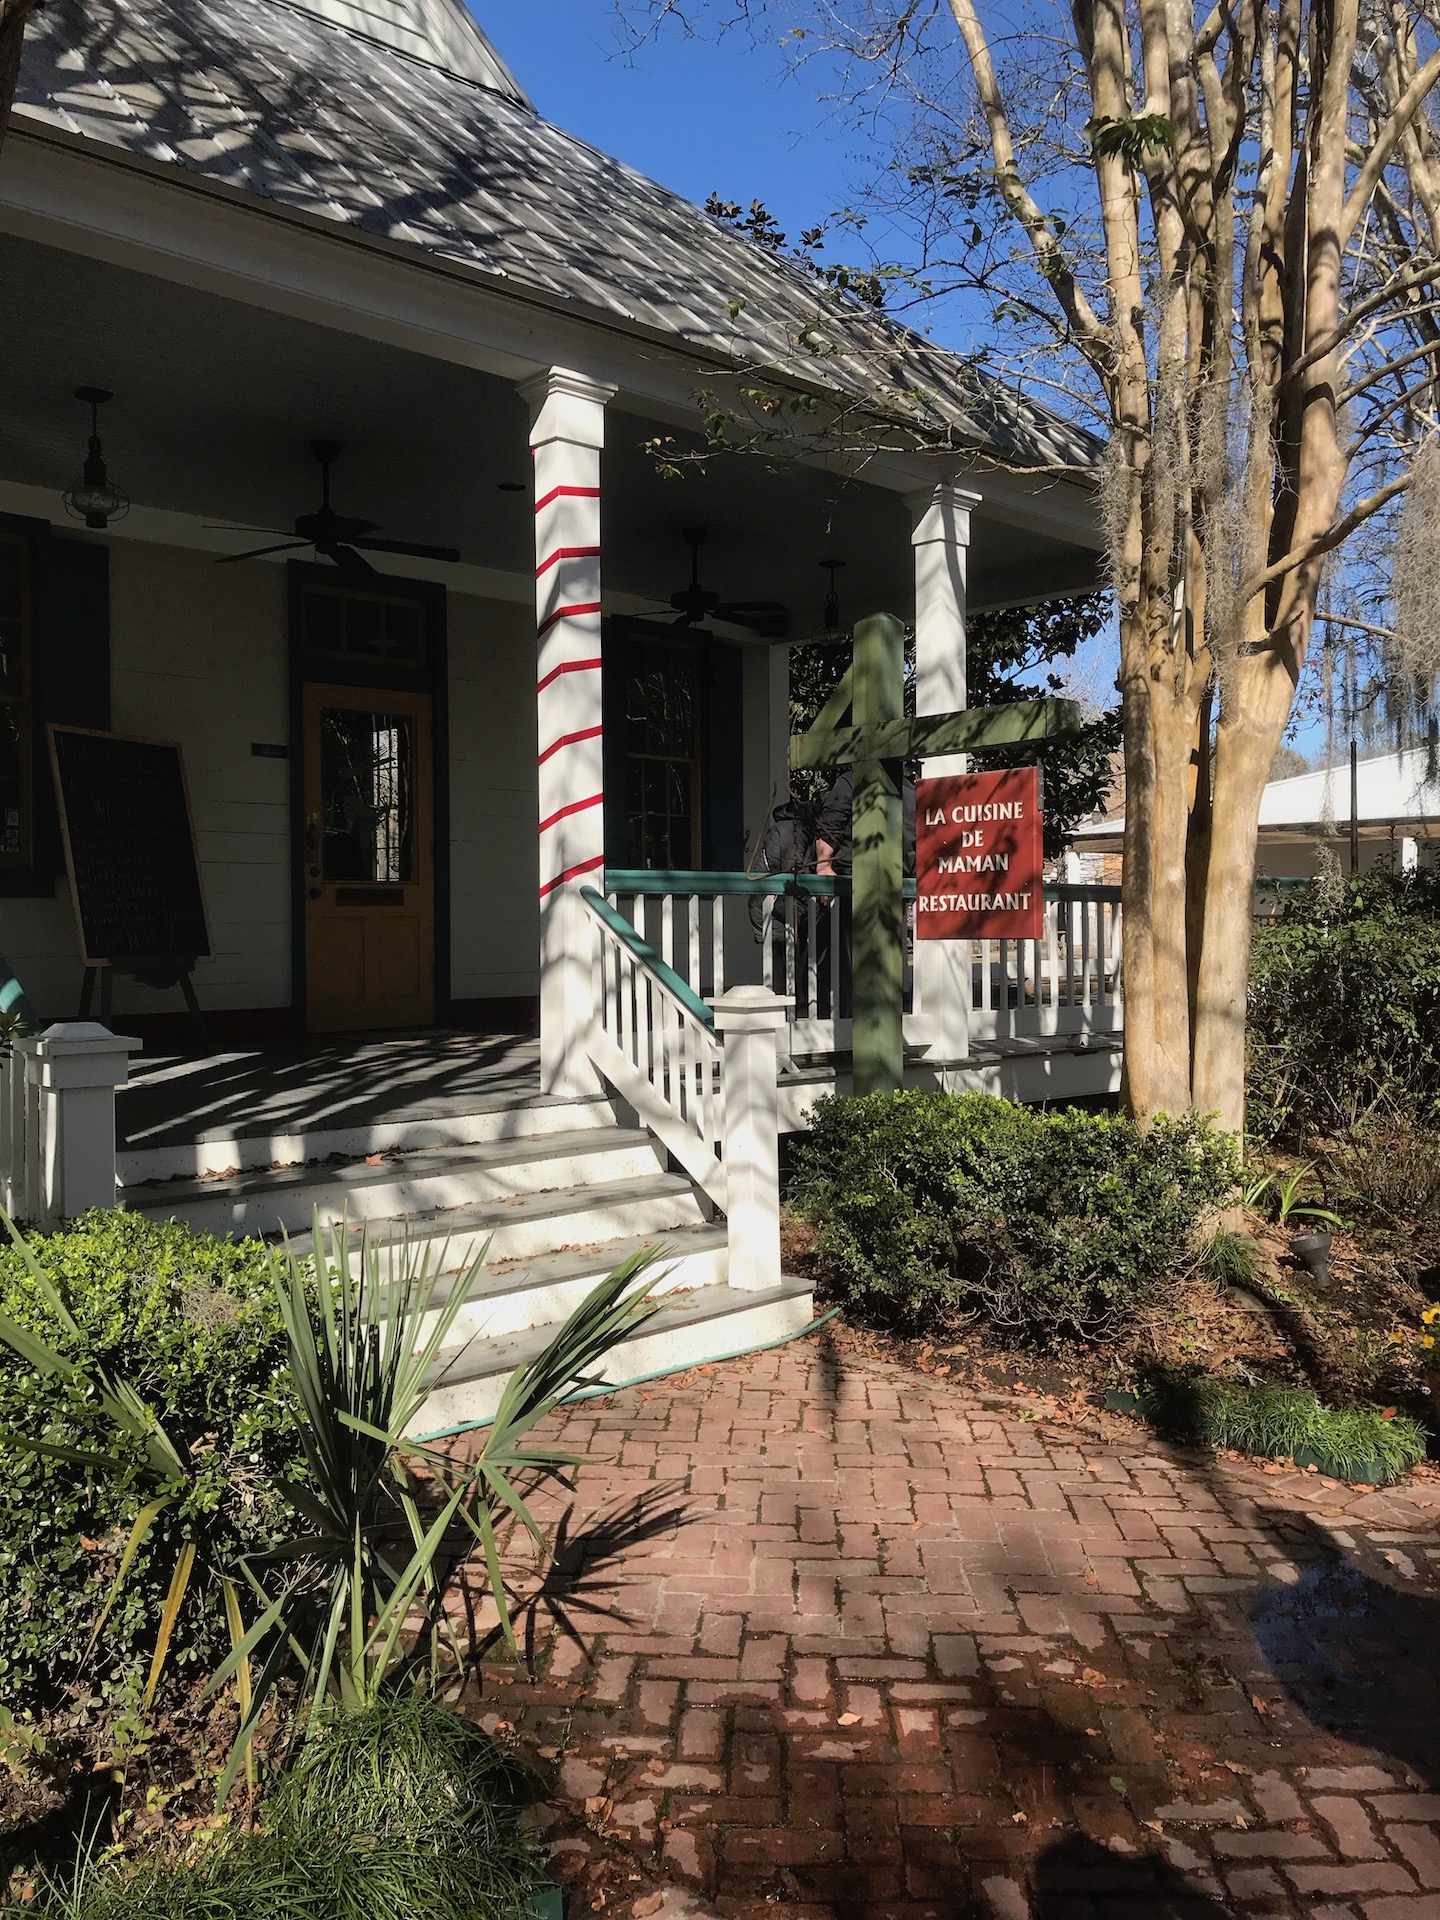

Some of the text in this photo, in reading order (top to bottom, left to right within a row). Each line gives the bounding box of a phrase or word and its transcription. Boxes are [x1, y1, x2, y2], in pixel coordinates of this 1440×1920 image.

[925, 801, 1024, 826] LA CUISINE
[961, 829, 984, 848] DE
[937, 853, 1009, 874] MAMAN
[918, 892, 1032, 912] RESTAURANT
